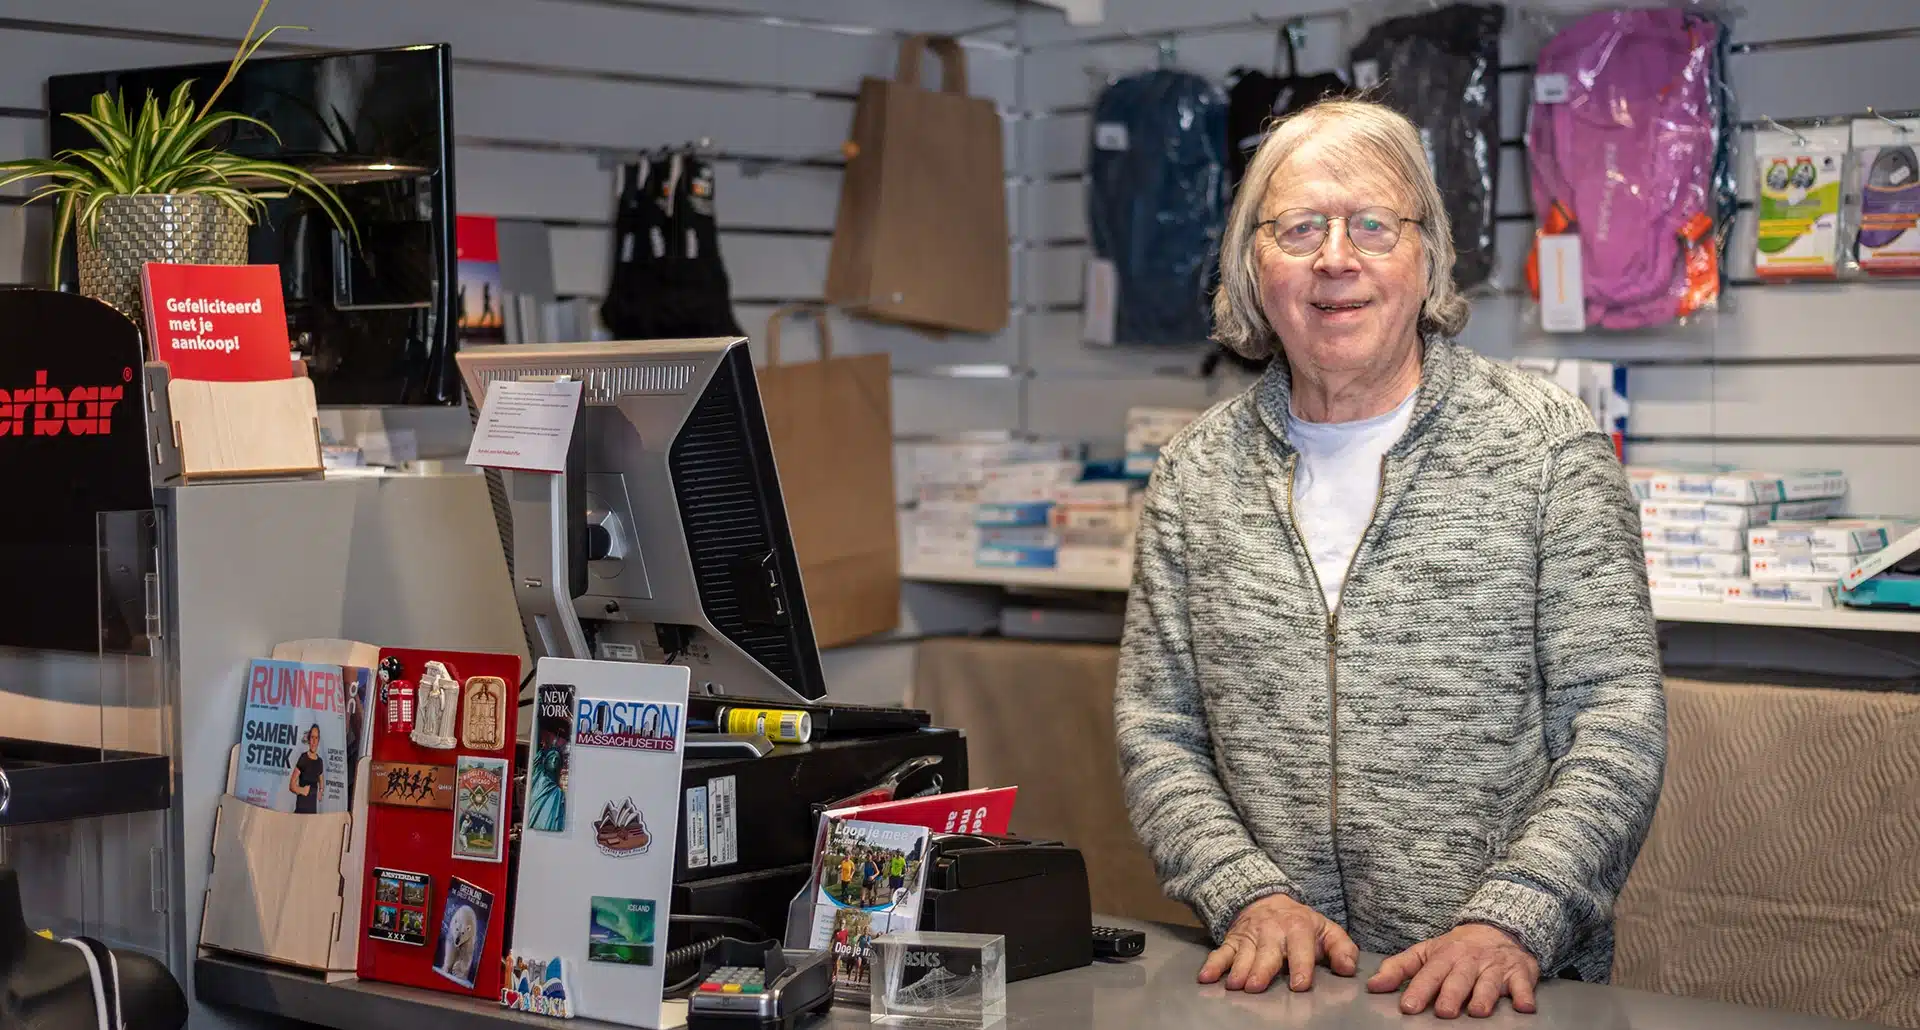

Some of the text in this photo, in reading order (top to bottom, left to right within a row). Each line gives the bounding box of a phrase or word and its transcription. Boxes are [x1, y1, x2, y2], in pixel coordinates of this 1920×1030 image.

[167, 298, 262, 315] Gefeliciteerd
[169, 318, 214, 335] met je
[172, 336, 241, 353] aankoop!
[544, 690, 568, 704] NEW
[541, 704, 569, 718] YORK
[577, 699, 680, 739] BOSTON
[245, 720, 298, 746] SAMEN
[577, 733, 674, 750] MASSACHUSETTS
[246, 743, 292, 769] STERK
[834, 822, 917, 842] Loop je mee?
[381, 871, 421, 883] AMSTERDAM
[628, 903, 651, 913] ICELAND
[834, 942, 852, 954] Doe
[851, 944, 862, 957] je
